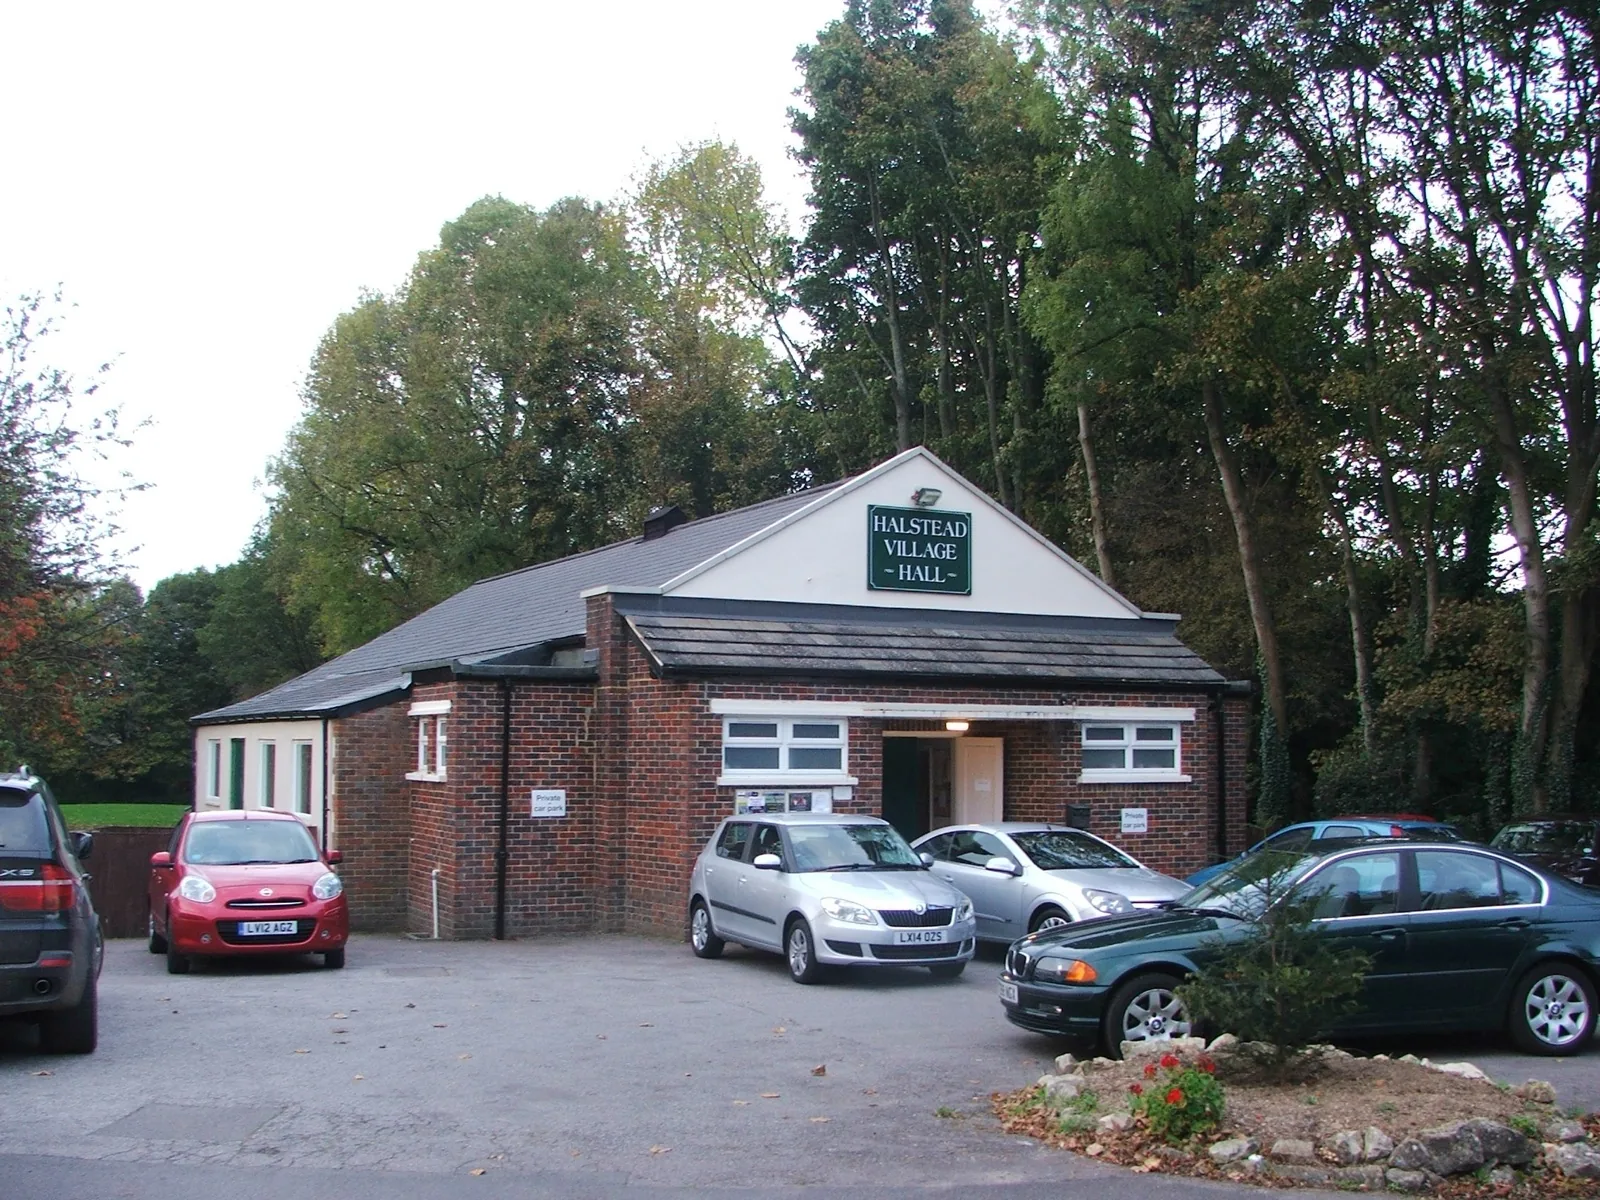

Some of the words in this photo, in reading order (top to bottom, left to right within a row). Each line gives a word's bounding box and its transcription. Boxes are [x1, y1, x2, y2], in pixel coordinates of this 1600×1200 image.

[873, 515, 967, 538] HALSTEAD
[884, 539, 957, 560] VILLAGE
[898, 564, 946, 583] HALL
[247, 923, 270, 933] LV12
[273, 922, 293, 932] AGZ
[900, 932, 921, 943] LX14
[924, 931, 942, 942] OZS
